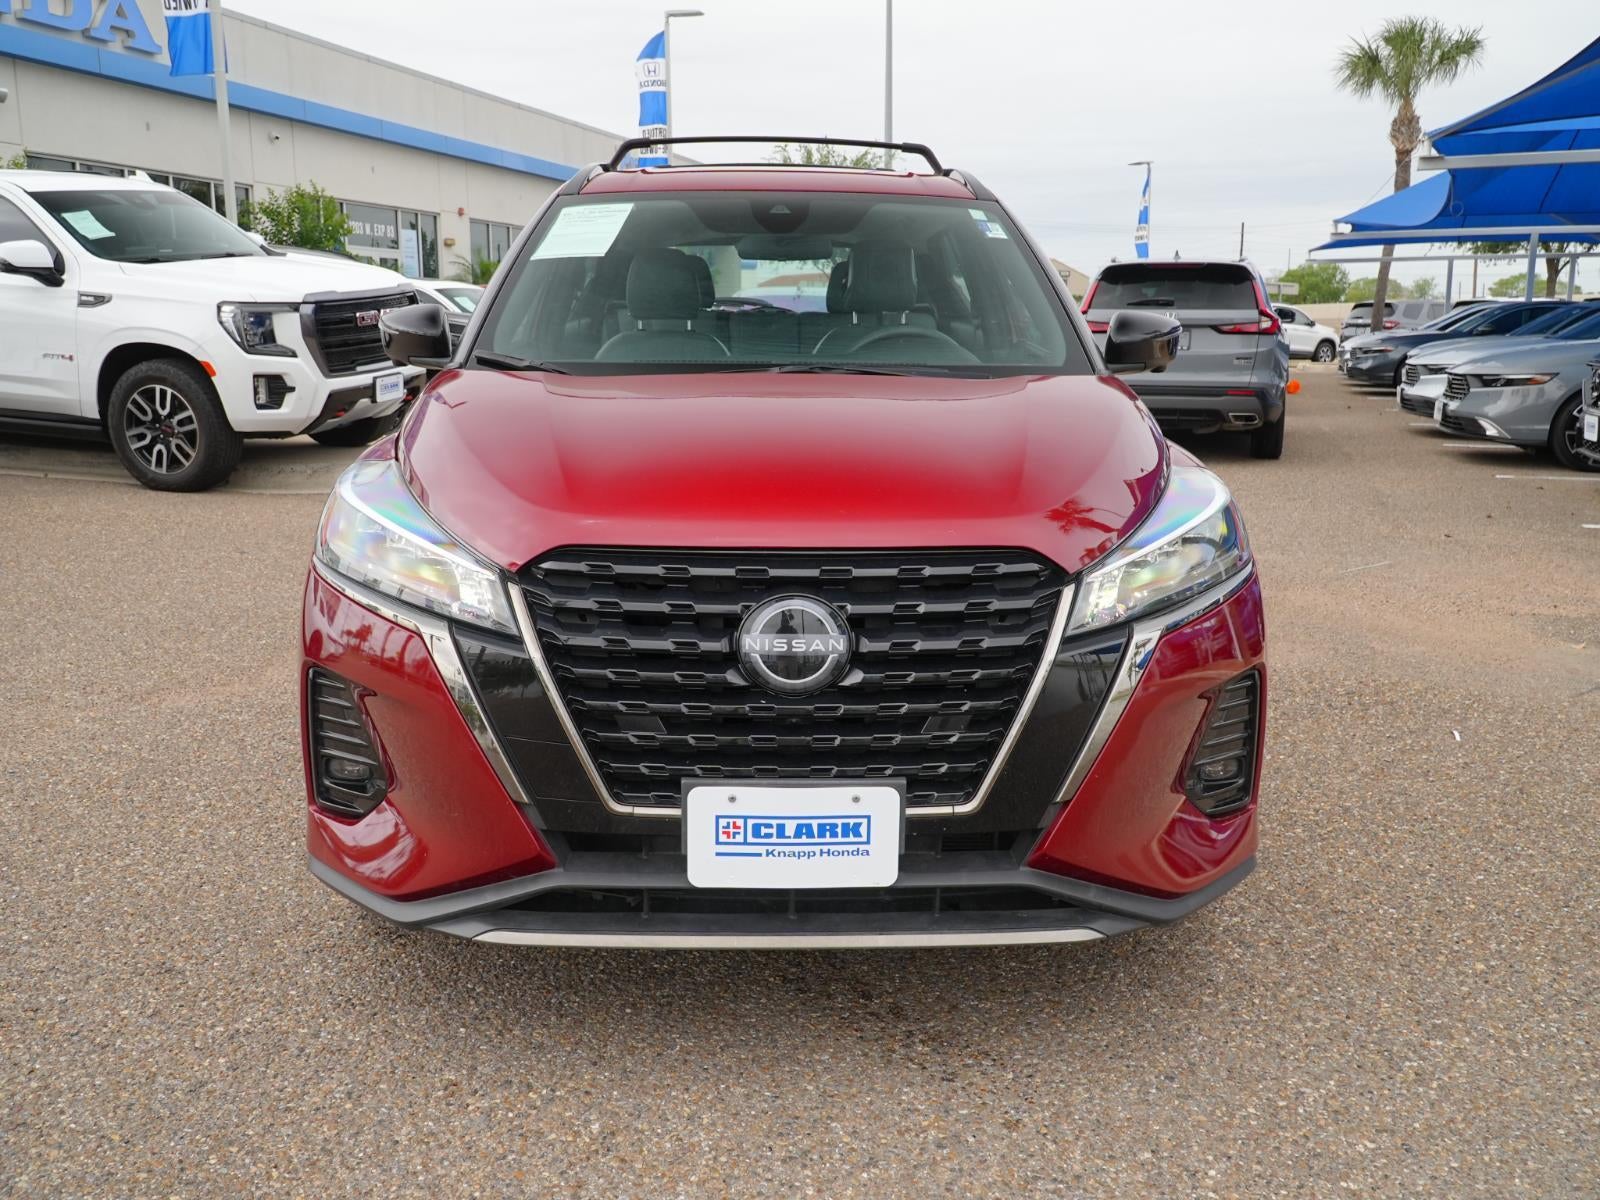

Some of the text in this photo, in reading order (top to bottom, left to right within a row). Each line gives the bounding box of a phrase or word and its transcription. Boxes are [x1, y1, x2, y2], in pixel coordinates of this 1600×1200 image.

[745, 638, 843, 652] NISSAN
[751, 822, 863, 840] CLARK
[765, 848, 870, 859] Knapp Honda
